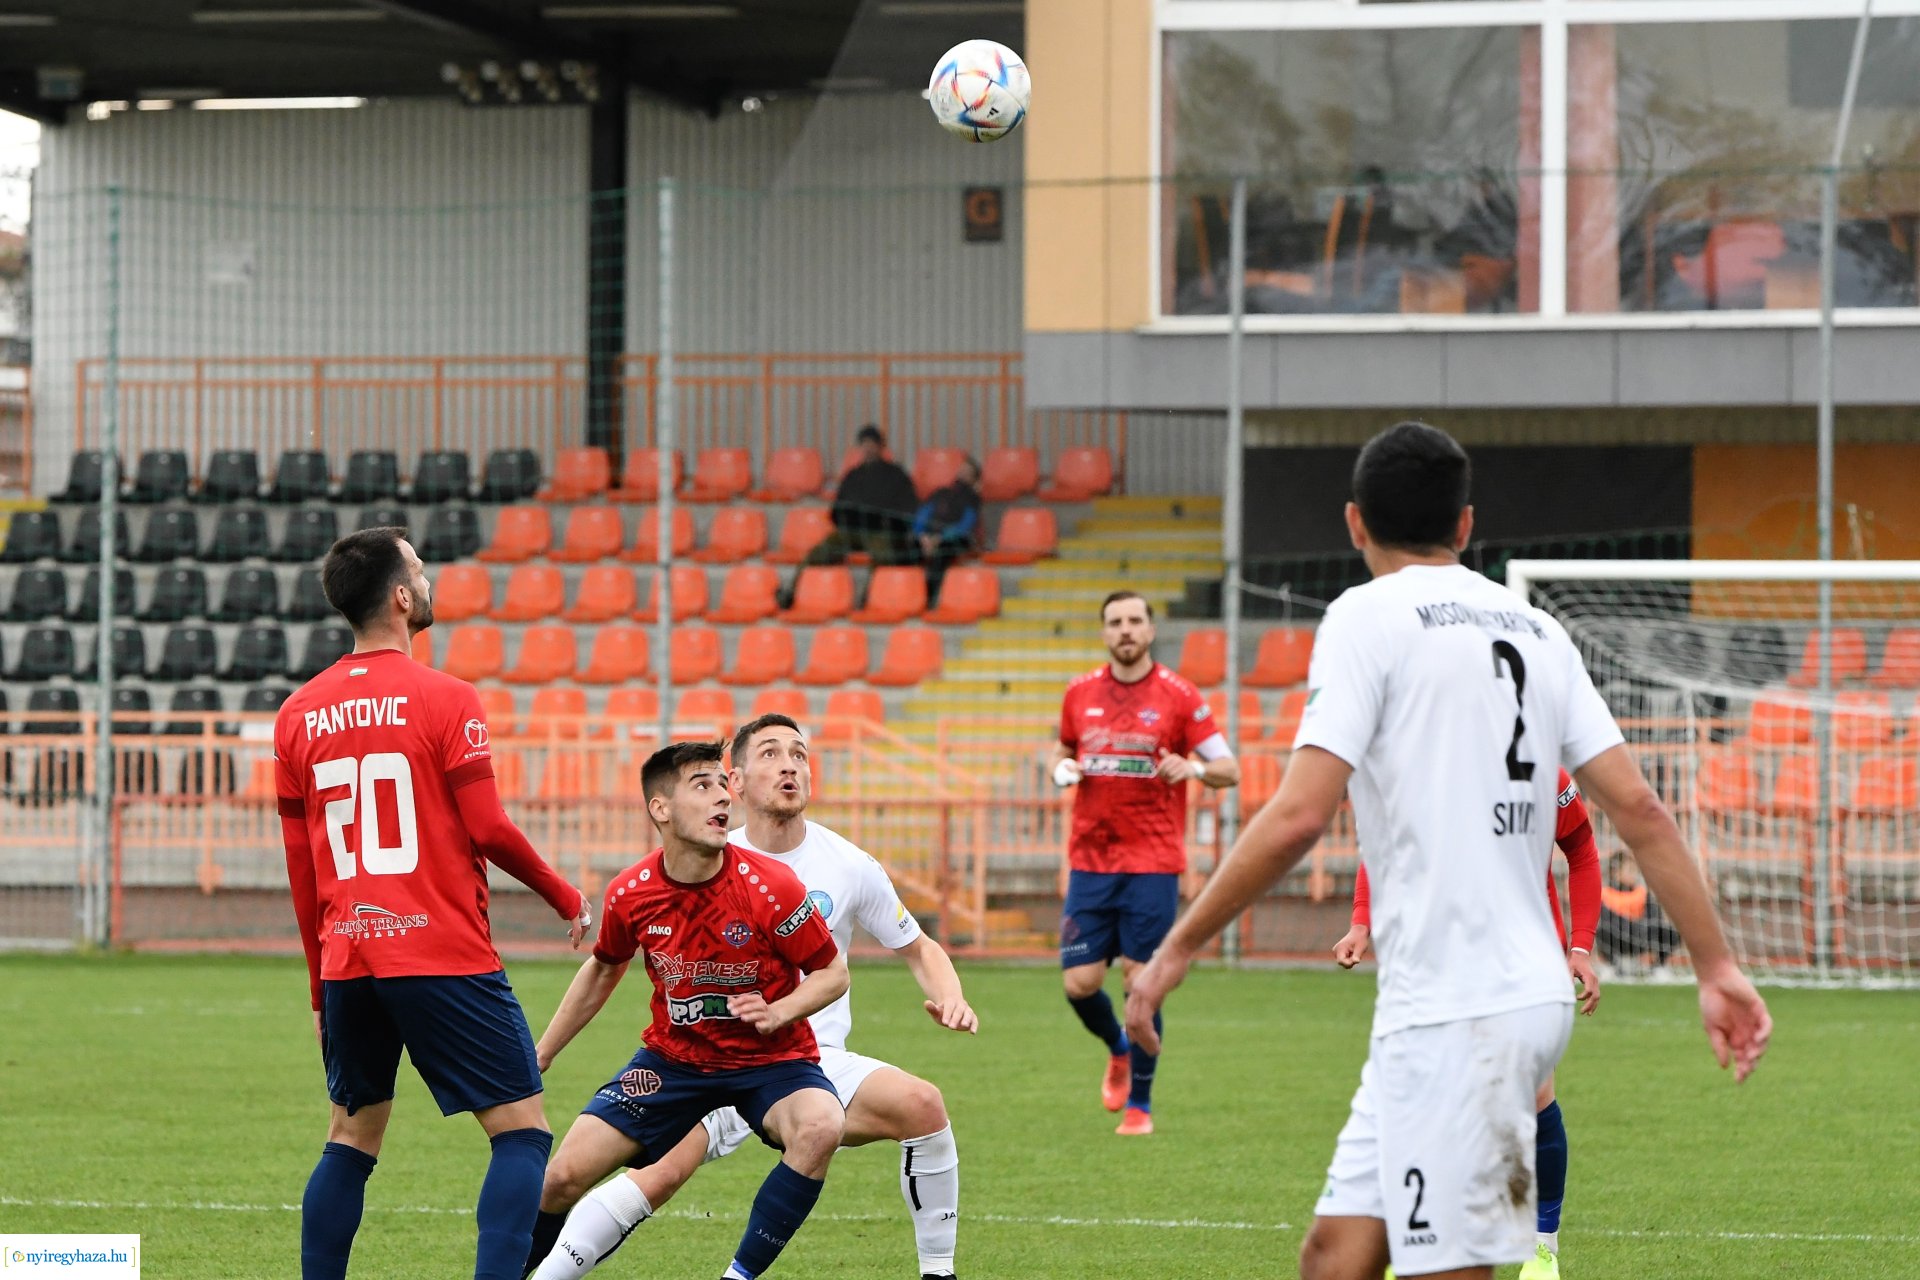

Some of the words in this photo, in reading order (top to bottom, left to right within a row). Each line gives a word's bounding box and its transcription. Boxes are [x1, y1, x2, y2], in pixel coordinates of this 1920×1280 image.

[965, 191, 998, 225] G
[304, 696, 408, 741] PANTOVIC
[1492, 640, 1535, 781] 2
[312, 752, 419, 880] 20
[370, 914, 428, 931] TRANS
[647, 925, 672, 935] JAKO
[681, 960, 759, 979] REVESZ
[600, 1089, 647, 1114] PRESTIGE
[1405, 1168, 1429, 1230] 2
[755, 1228, 786, 1247] JAKO
[561, 1241, 584, 1267] JAKO
